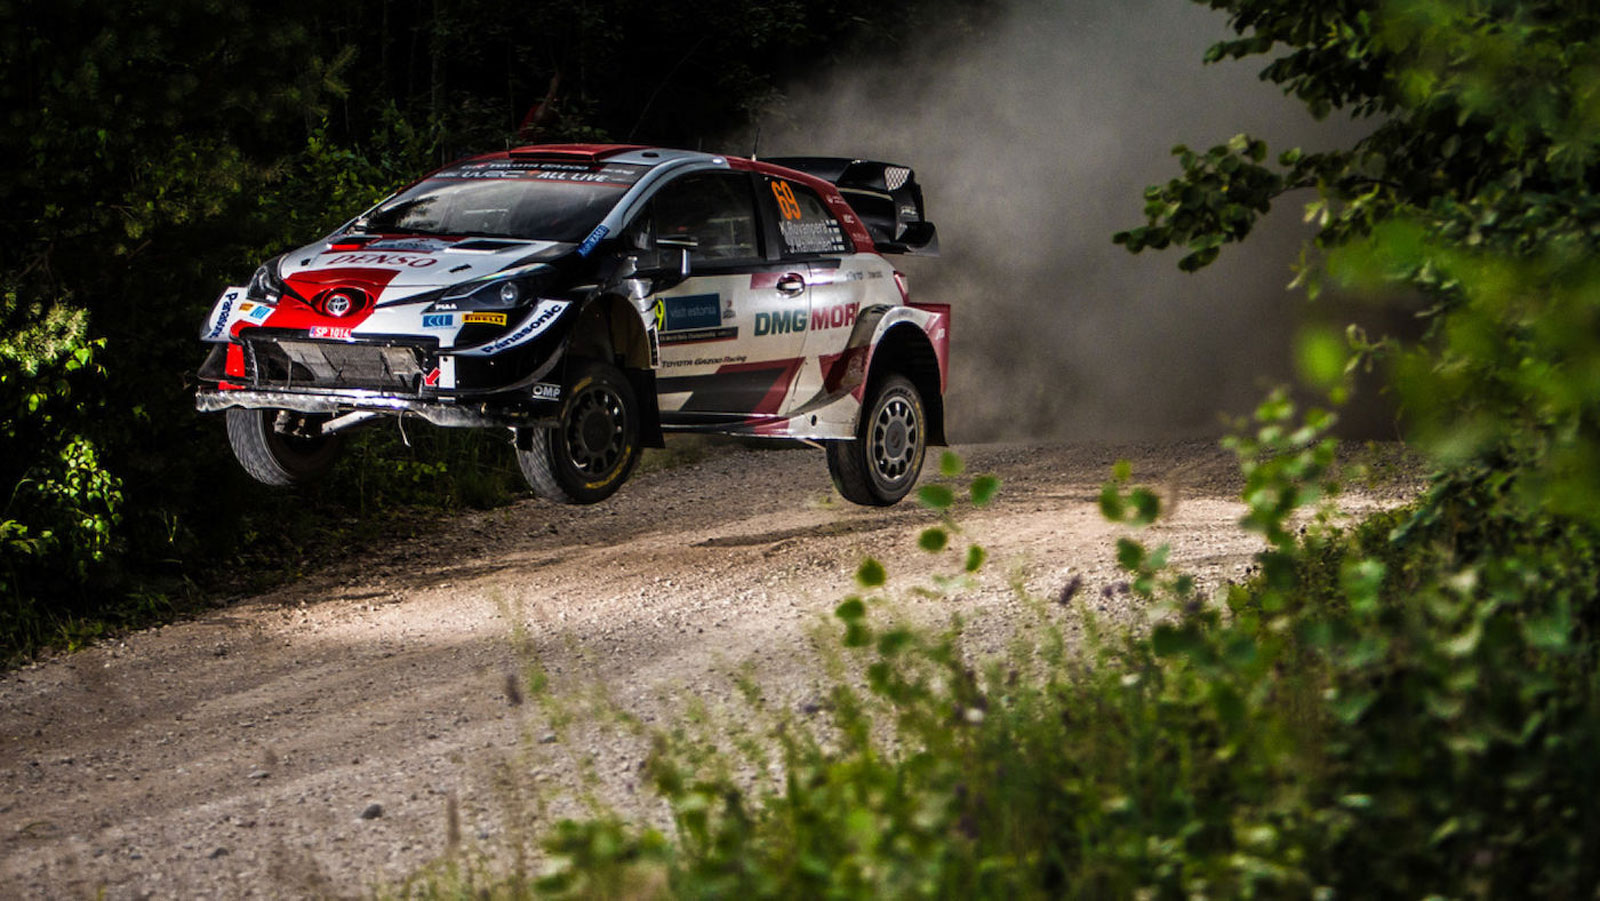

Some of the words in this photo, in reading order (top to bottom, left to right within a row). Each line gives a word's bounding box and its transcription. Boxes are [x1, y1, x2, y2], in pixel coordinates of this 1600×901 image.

[536, 171, 568, 180] ALL
[570, 173, 609, 182] LIVE
[771, 181, 801, 220] 69
[326, 254, 438, 268] DENSO
[435, 303, 457, 311] PIAA
[464, 314, 505, 325] PIRELLI
[754, 311, 808, 336] DMG
[316, 327, 328, 337] SP
[330, 328, 350, 338] 1014
[481, 304, 563, 353] Panasonic
[662, 359, 694, 369] TOYOTA
[694, 357, 723, 366] GAZOO
[723, 355, 748, 364] Racing
[532, 385, 561, 398] OMP
